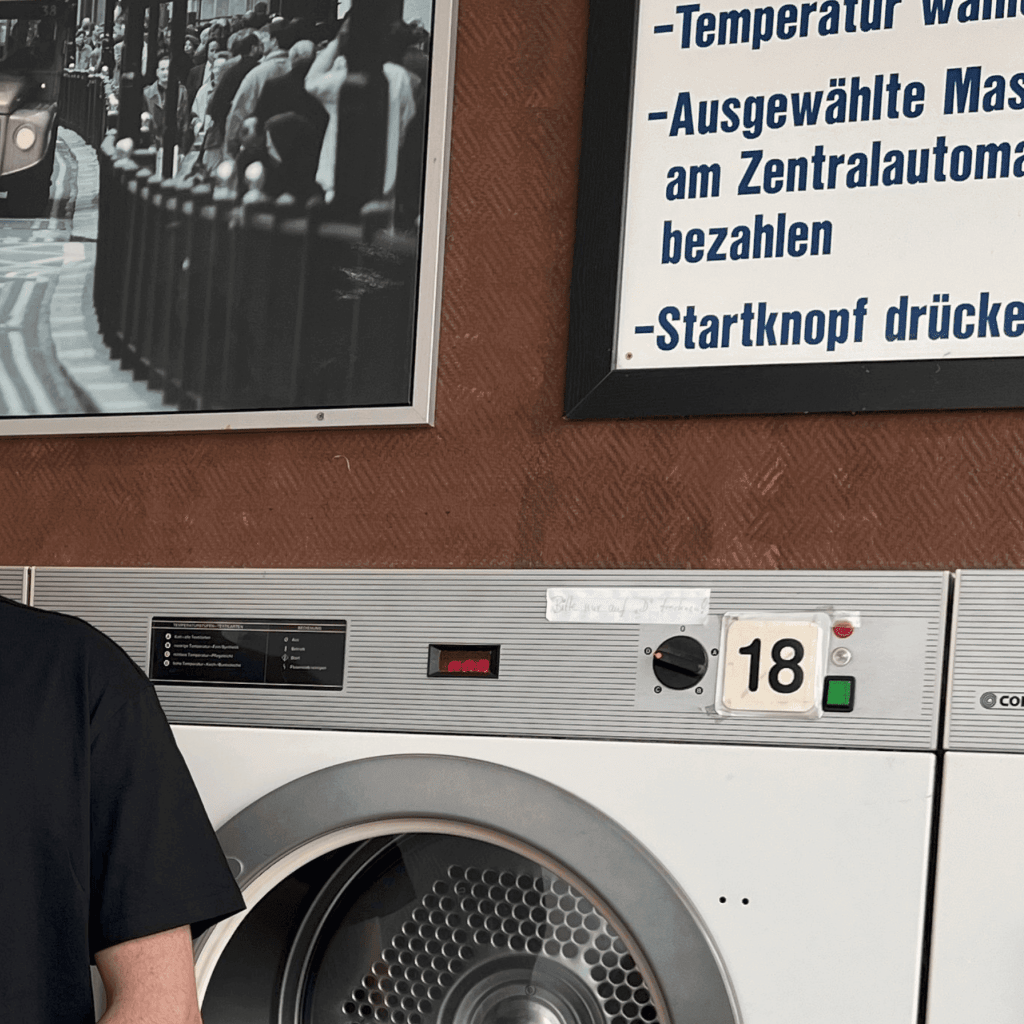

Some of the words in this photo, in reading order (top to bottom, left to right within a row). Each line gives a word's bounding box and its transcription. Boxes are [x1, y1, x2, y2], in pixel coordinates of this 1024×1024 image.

[943, 66, 1024, 115] Mas
[666, 163, 721, 201] am
[661, 213, 833, 264] bezahlen
[885, 292, 1024, 342] drücke
[738, 637, 805, 694] 18
[999, 695, 1024, 708] CO
